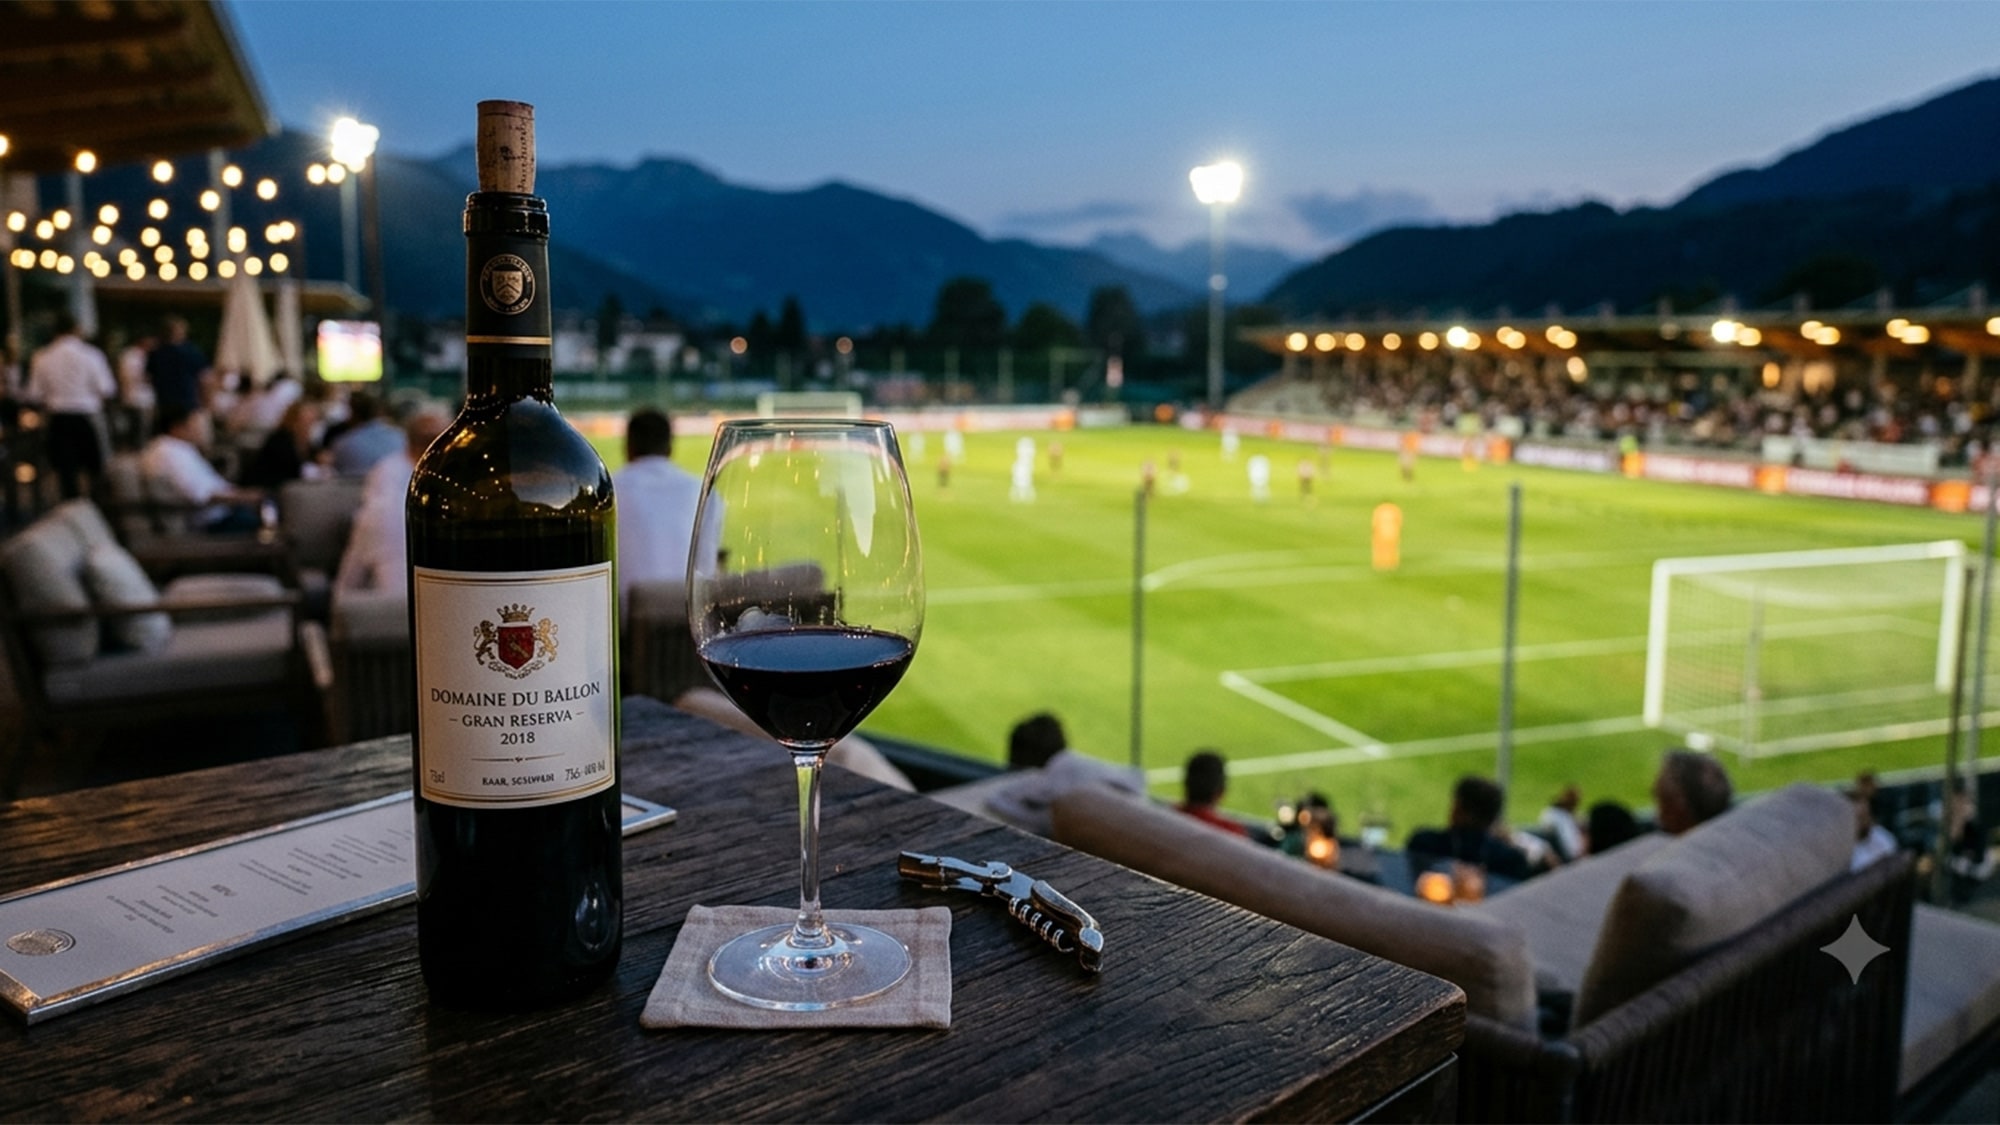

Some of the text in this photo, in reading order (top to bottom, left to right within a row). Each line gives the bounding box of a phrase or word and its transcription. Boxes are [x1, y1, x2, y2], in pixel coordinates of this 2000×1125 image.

[431, 681, 600, 707] DOMAINE DU BALLON
[462, 709, 572, 728] GRAN RESERVA
[500, 731, 536, 745] 2018
